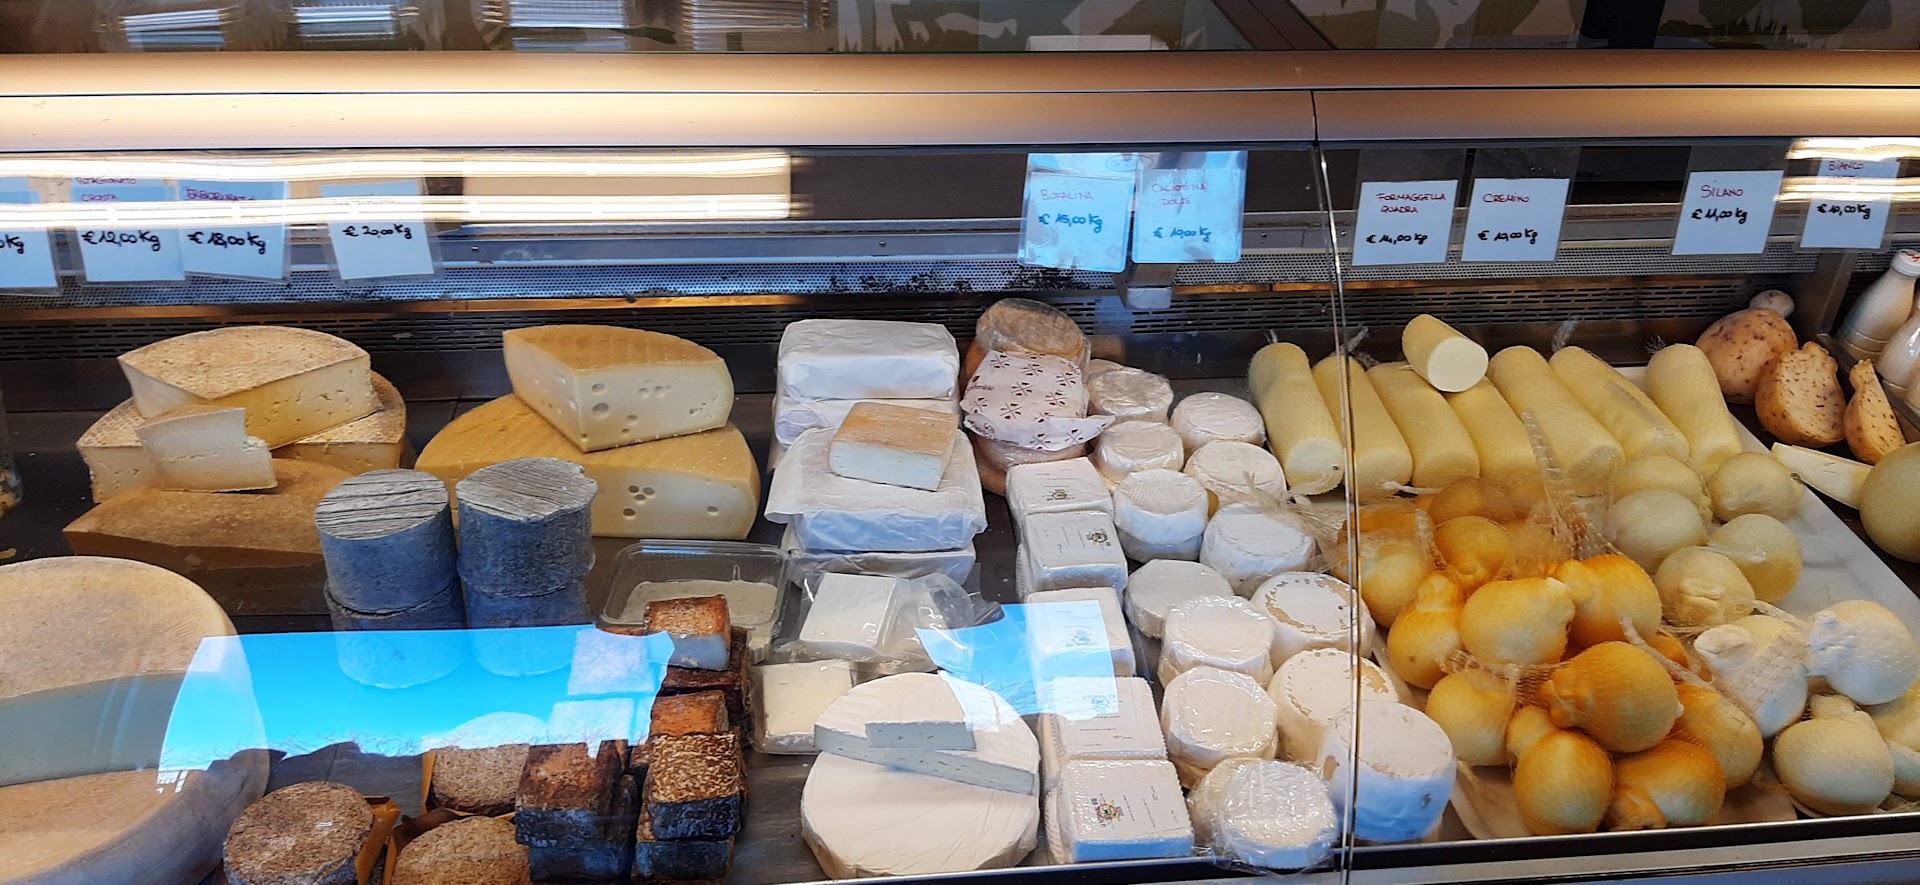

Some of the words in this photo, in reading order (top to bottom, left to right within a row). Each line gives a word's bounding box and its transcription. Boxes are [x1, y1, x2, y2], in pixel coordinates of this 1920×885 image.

[1828, 160, 1864, 171] BIANCO
[1040, 188, 1095, 201] BUFALINA
[1701, 180, 1744, 198] SILANO
[1376, 193, 1446, 202] FORMAGGELLA
[1483, 192, 1530, 203] CREMINO
[1380, 205, 1419, 214] QUADRA
[1055, 213, 1086, 227] 15,00
[361, 225, 394, 239] 20,00
[207, 232, 246, 249] 18,00
